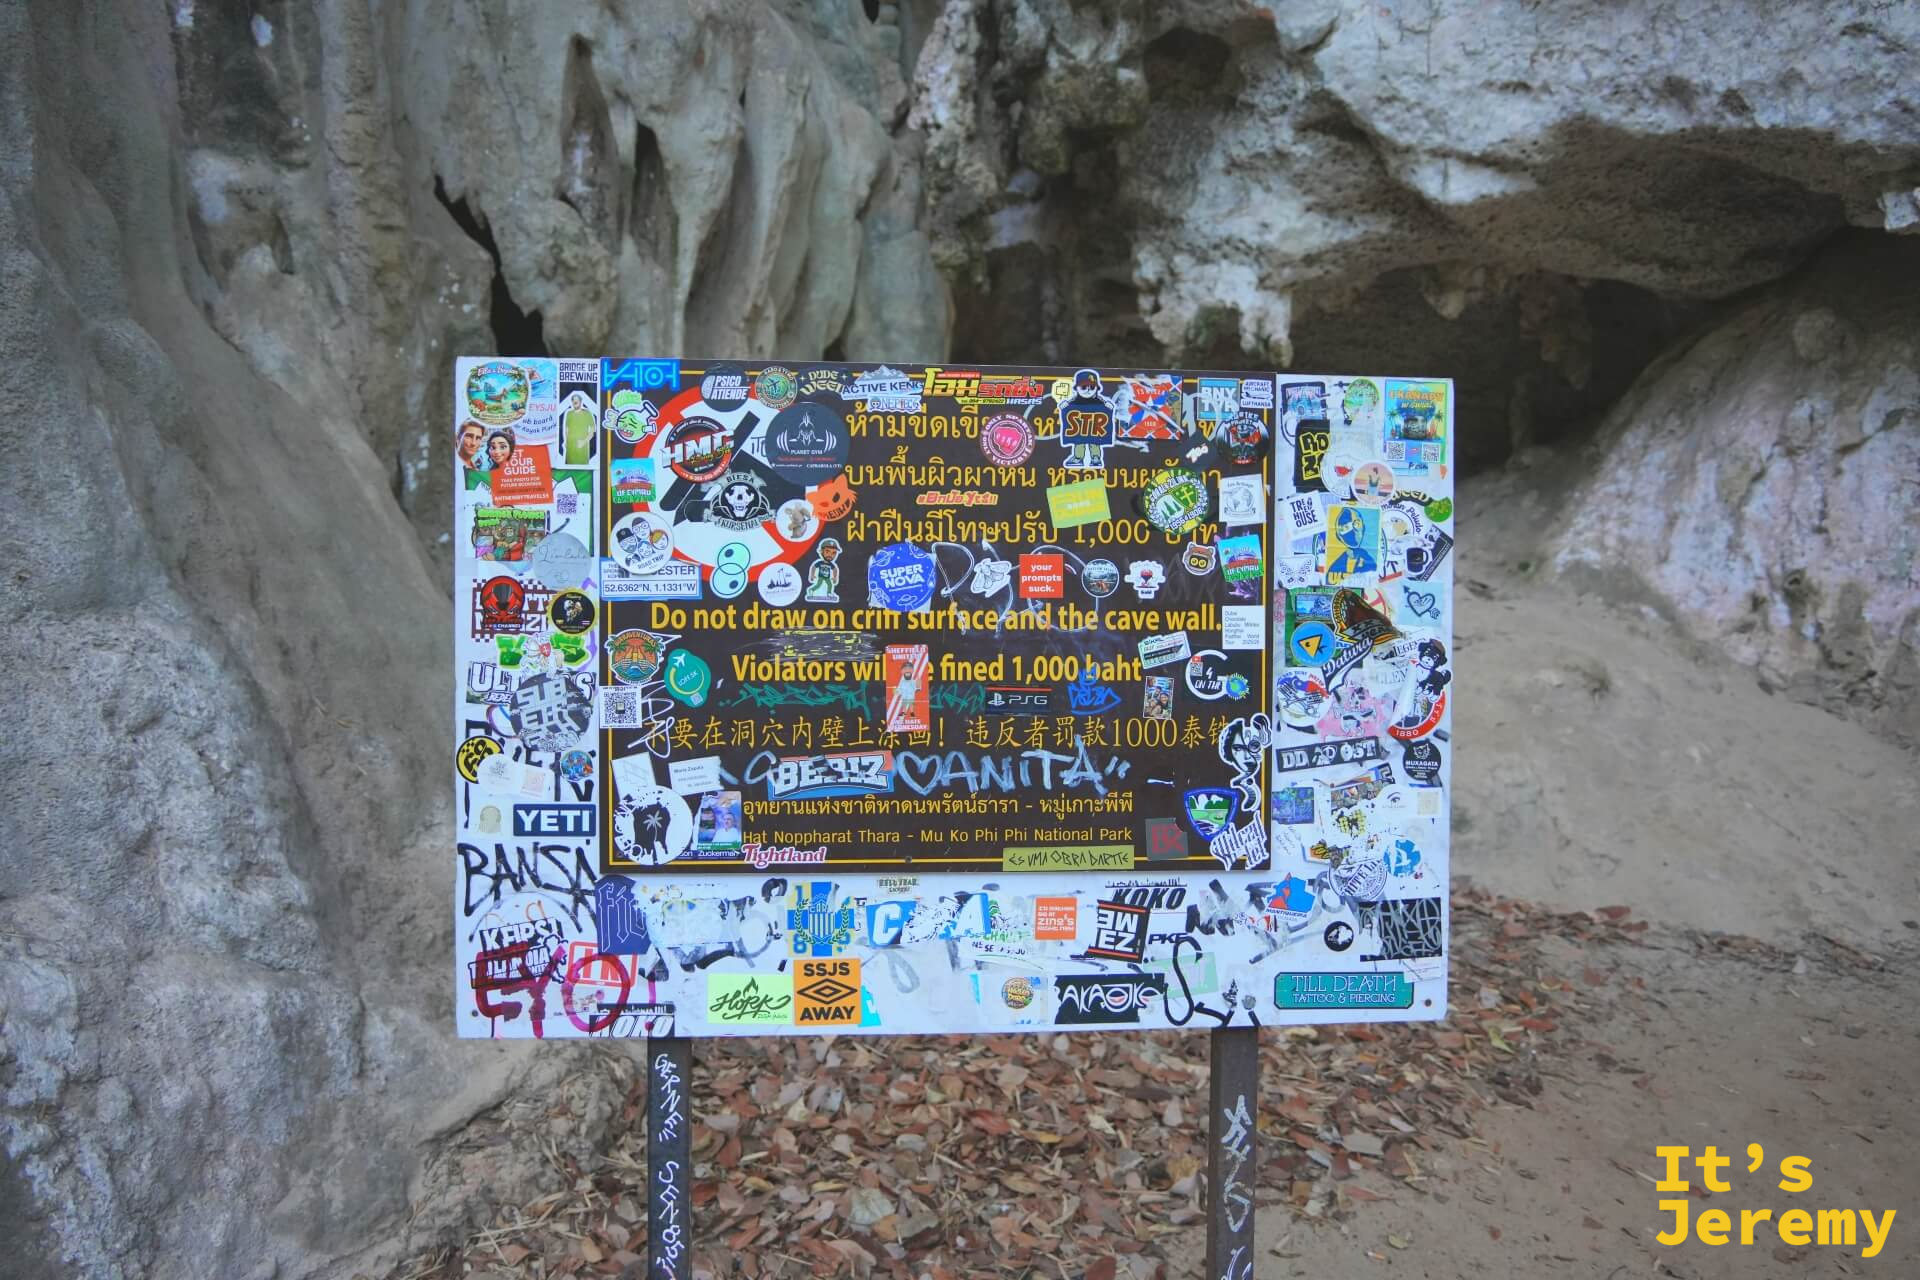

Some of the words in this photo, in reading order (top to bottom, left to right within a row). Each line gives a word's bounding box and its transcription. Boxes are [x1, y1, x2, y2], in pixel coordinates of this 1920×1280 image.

[560, 362, 587, 372] BRIDGE
[588, 363, 598, 372] UP
[560, 371, 598, 382] BREWING
[715, 375, 742, 386] PSICO
[1065, 409, 1109, 438] STR
[503, 466, 537, 476] GUIDE
[880, 563, 923, 580] SUPER
[1030, 563, 1053, 573] your
[884, 573, 926, 589] NOVA
[1021, 573, 1062, 584] prompts
[1028, 585, 1055, 593] suck.
[651, 602, 687, 630] Do
[693, 604, 737, 630] not
[743, 601, 807, 630] draw
[813, 609, 845, 630] on
[907, 602, 998, 631] surface
[1004, 603, 1051, 630] and
[1058, 603, 1099, 631] the
[1105, 610, 1160, 631] cave
[1166, 603, 1222, 631] wall.
[731, 653, 846, 682] Violators
[852, 654, 887, 682] wil
[940, 653, 1004, 682] fined
[1012, 655, 1079, 685] 1,000
[1086, 653, 1143, 682] baht
[516, 809, 592, 832] YETI
[743, 829, 768, 844] Hat
[774, 829, 852, 847] Noppharat
[858, 829, 900, 843] Thara
[920, 829, 944, 842] Mu
[950, 829, 969, 842] Ko
[975, 828, 998, 842] Phi
[1005, 828, 1028, 842] Phi
[1034, 828, 1093, 841] National
[1100, 828, 1133, 841] Park
[803, 962, 850, 977] SSJS
[1291, 975, 1327, 992] TILL
[1333, 975, 1397, 992] DEATH
[1293, 993, 1334, 1003] TATTOO
[1338, 993, 1346, 1003] &
[1349, 993, 1396, 1003] PIERCING
[799, 1006, 855, 1021] AWAY
